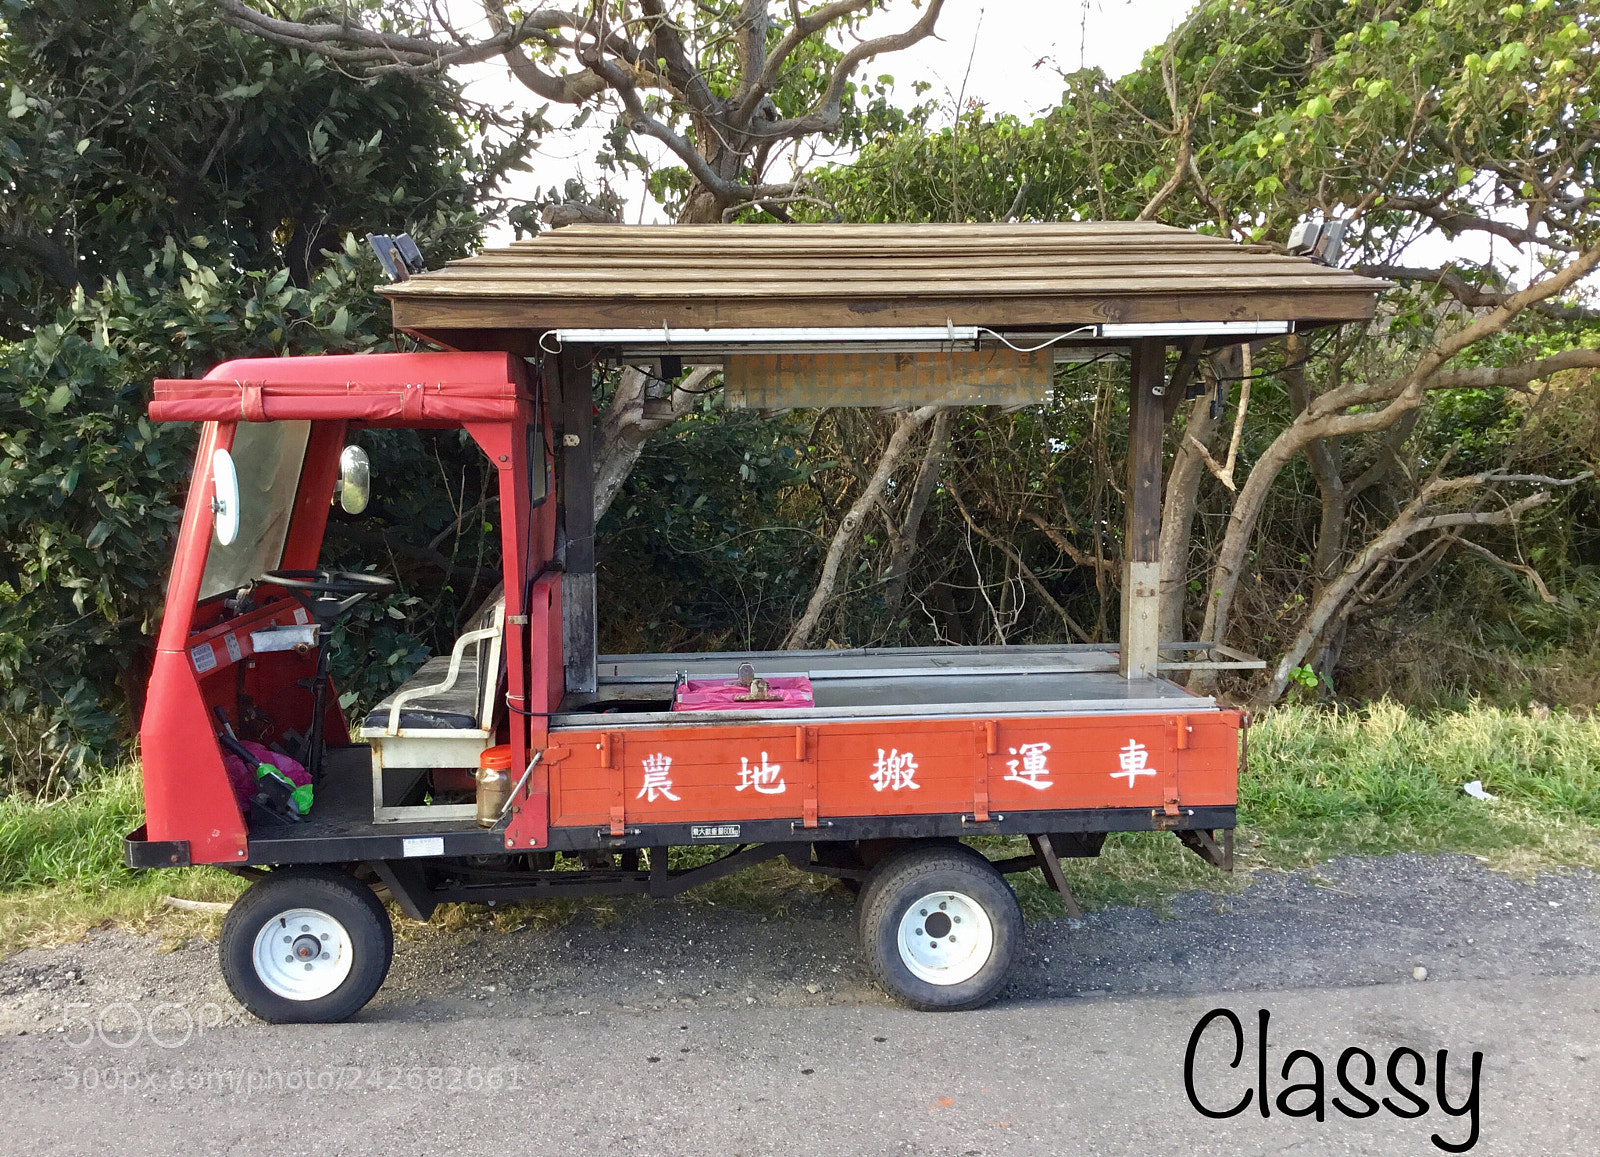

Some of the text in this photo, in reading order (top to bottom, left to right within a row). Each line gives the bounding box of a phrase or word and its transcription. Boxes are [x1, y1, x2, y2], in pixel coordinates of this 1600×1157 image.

[637, 738, 1158, 803] 農地搬運車
